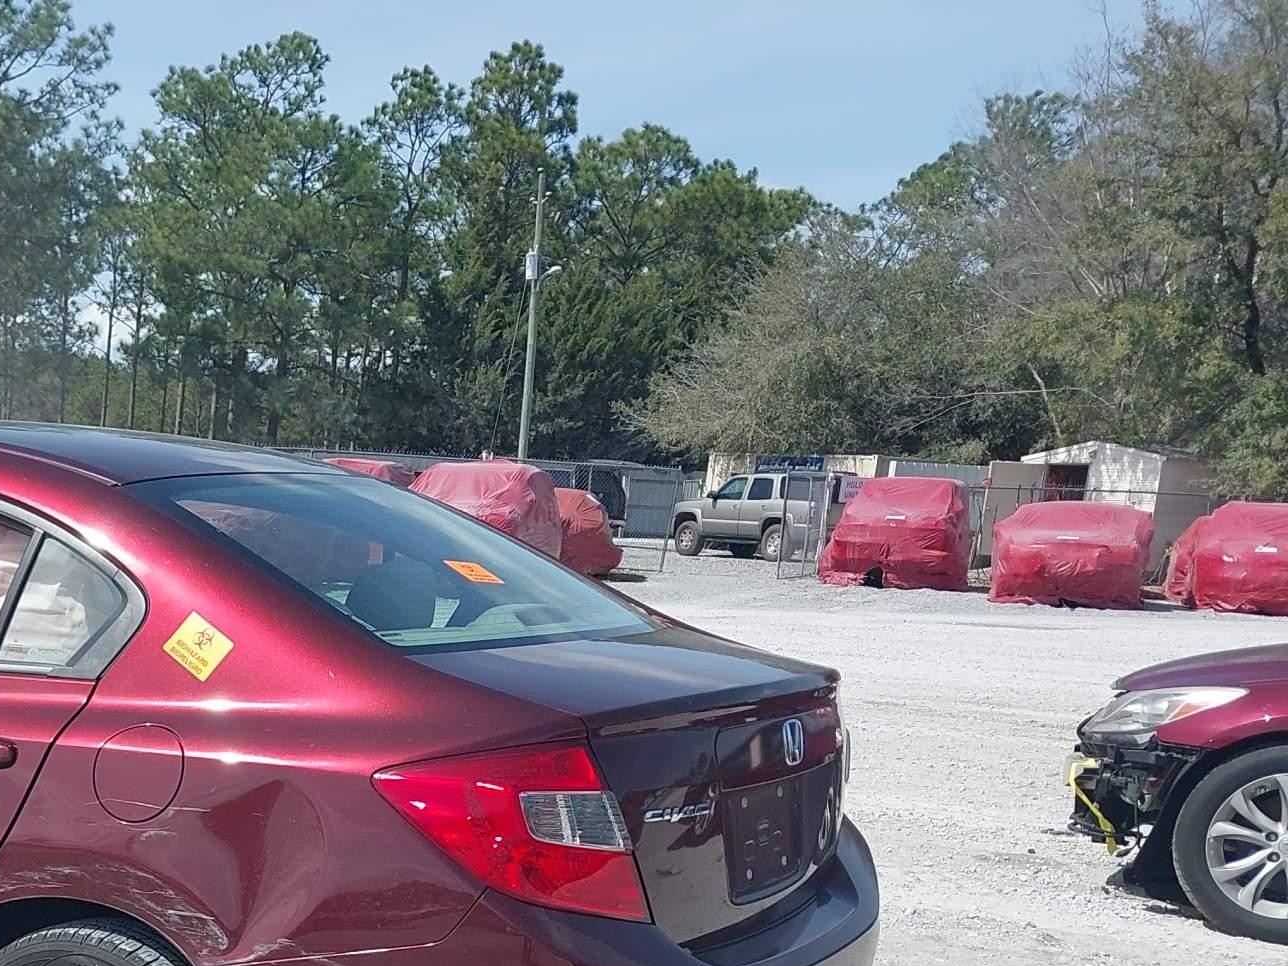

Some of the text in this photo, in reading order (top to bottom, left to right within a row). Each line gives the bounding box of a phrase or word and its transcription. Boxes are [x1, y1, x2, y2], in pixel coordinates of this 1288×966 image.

[846, 480, 864, 489] HOLD
[176, 639, 209, 668] BIOHAZARD
[643, 804, 710, 823] CIVIC
